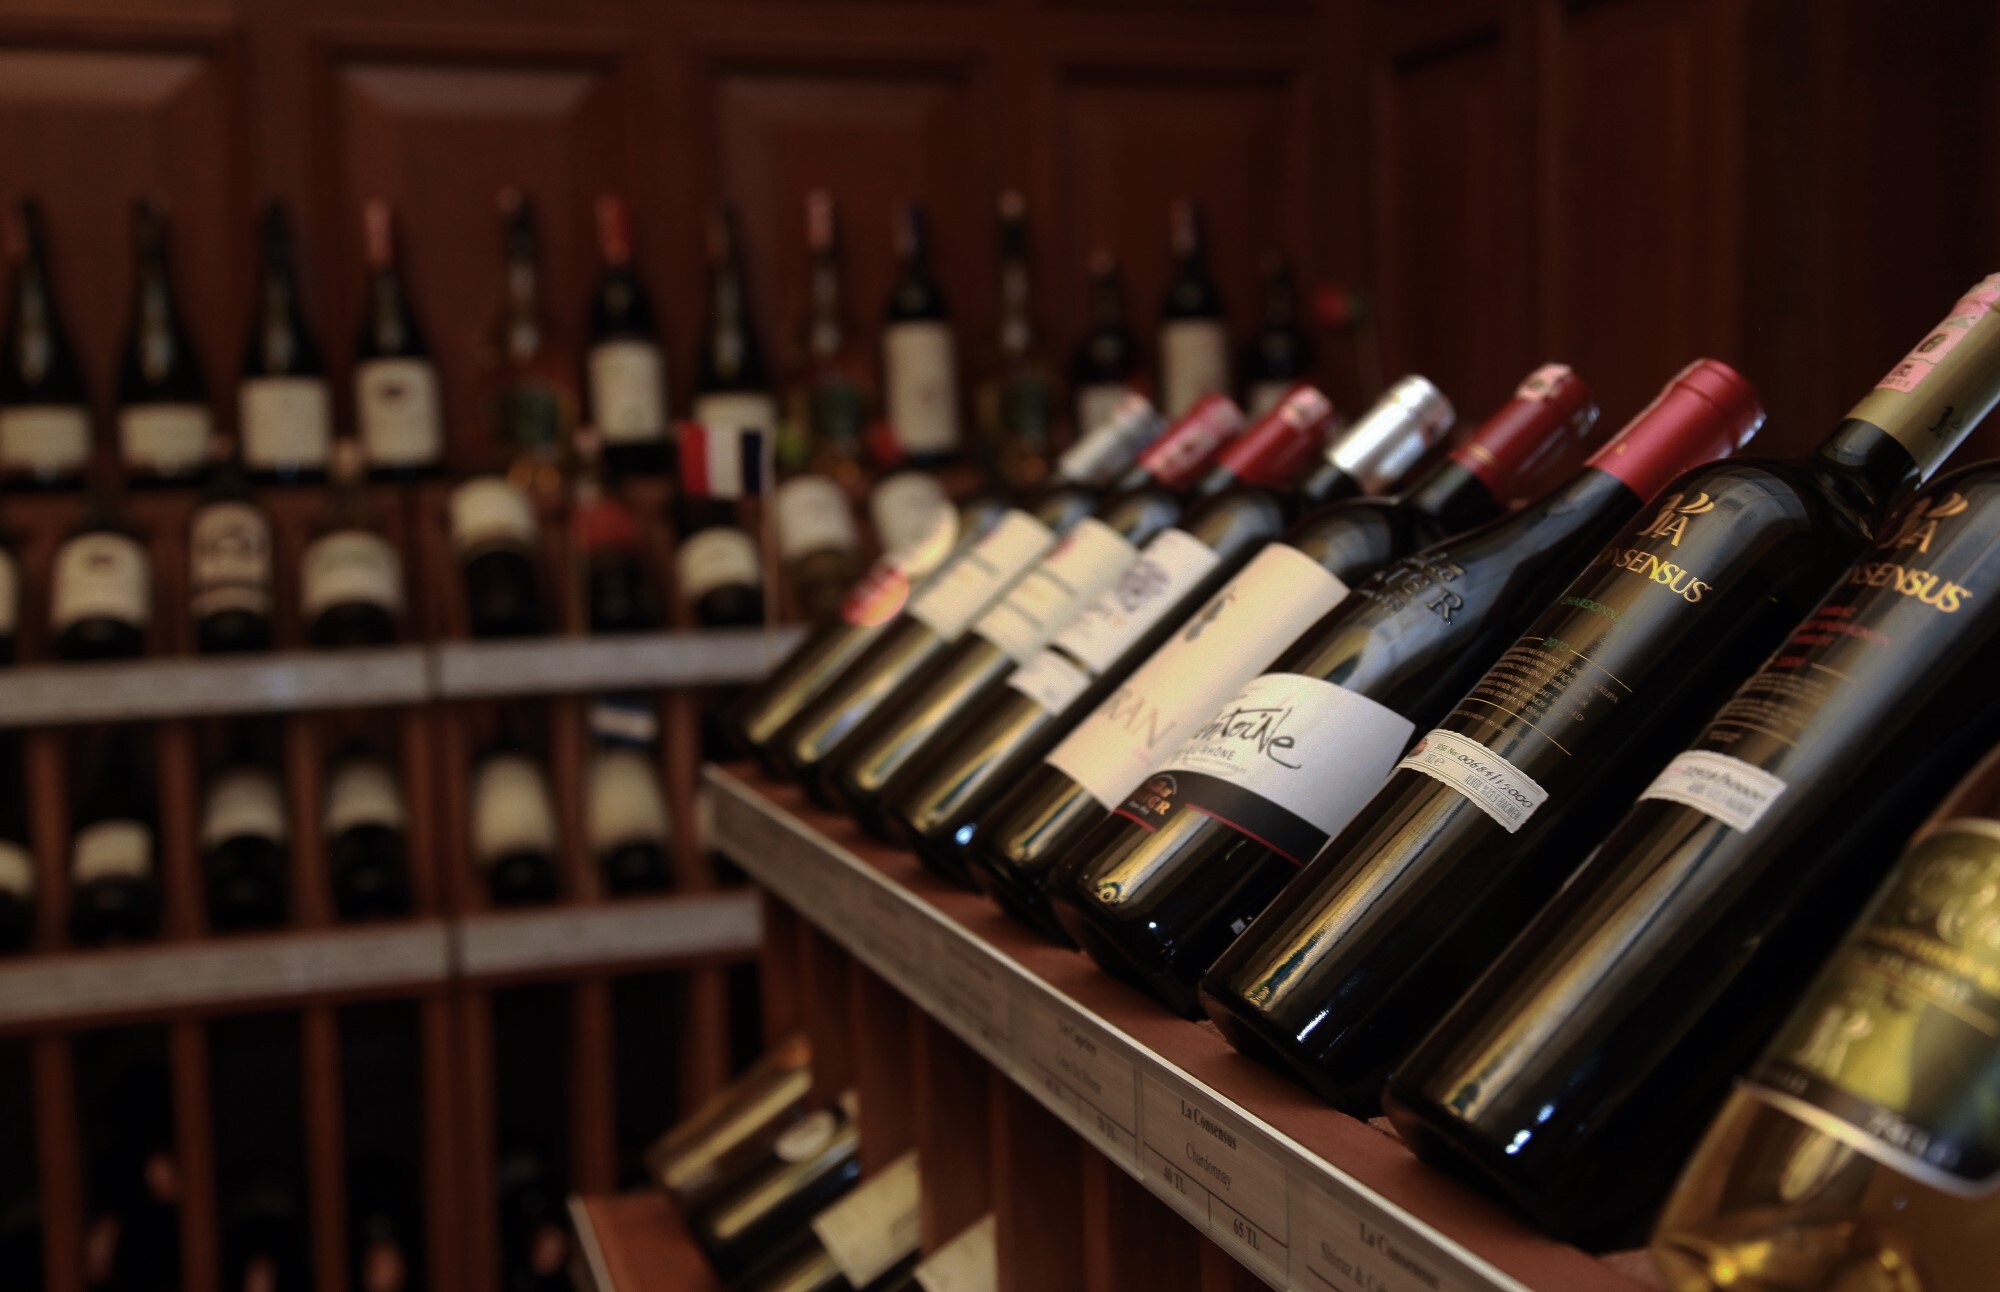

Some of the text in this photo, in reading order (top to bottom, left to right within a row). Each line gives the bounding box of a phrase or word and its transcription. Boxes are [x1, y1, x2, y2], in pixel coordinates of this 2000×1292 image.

[1543, 636, 1571, 652] 2010
[1181, 1099, 1237, 1150] La Consensus
[1186, 1142, 1232, 1191] Chardonnay
[1174, 1172, 1186, 1195] TL
[1233, 1218, 1260, 1251] 65 TL
